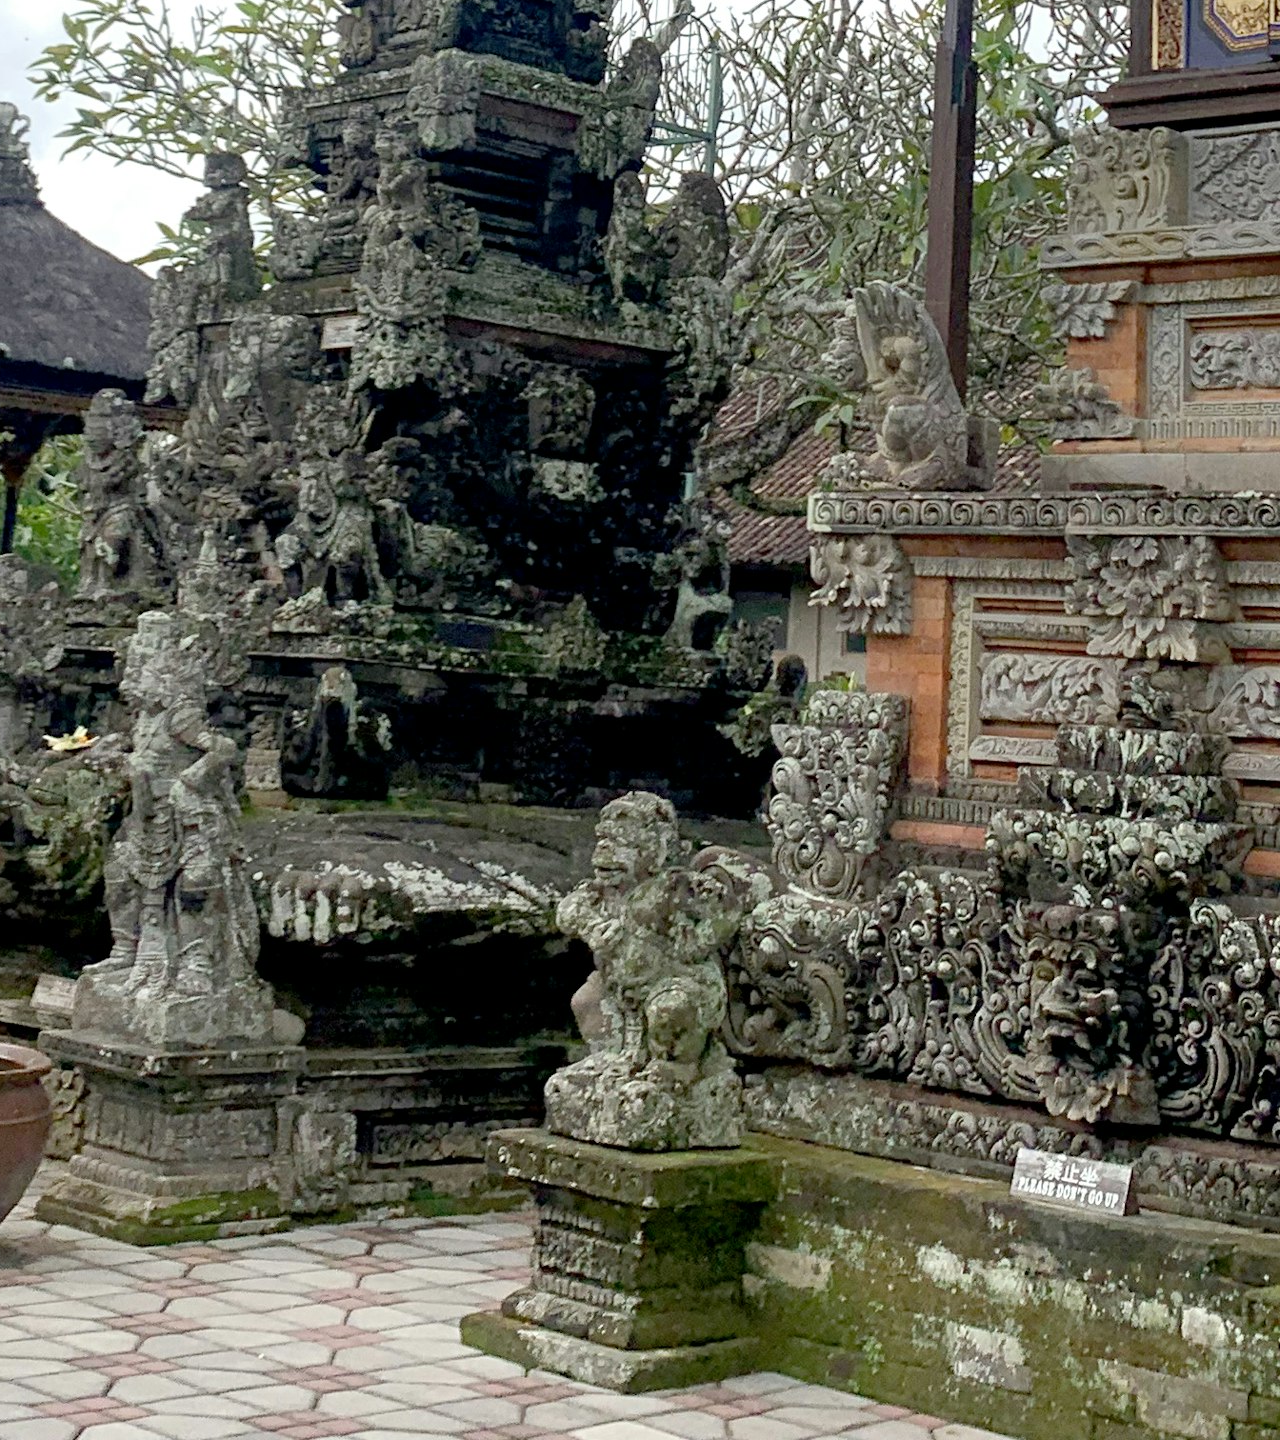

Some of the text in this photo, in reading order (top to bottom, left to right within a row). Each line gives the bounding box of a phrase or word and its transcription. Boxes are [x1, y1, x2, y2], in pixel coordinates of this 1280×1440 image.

[1017, 1176, 1119, 1208] PLEASE DON'T GO UP
